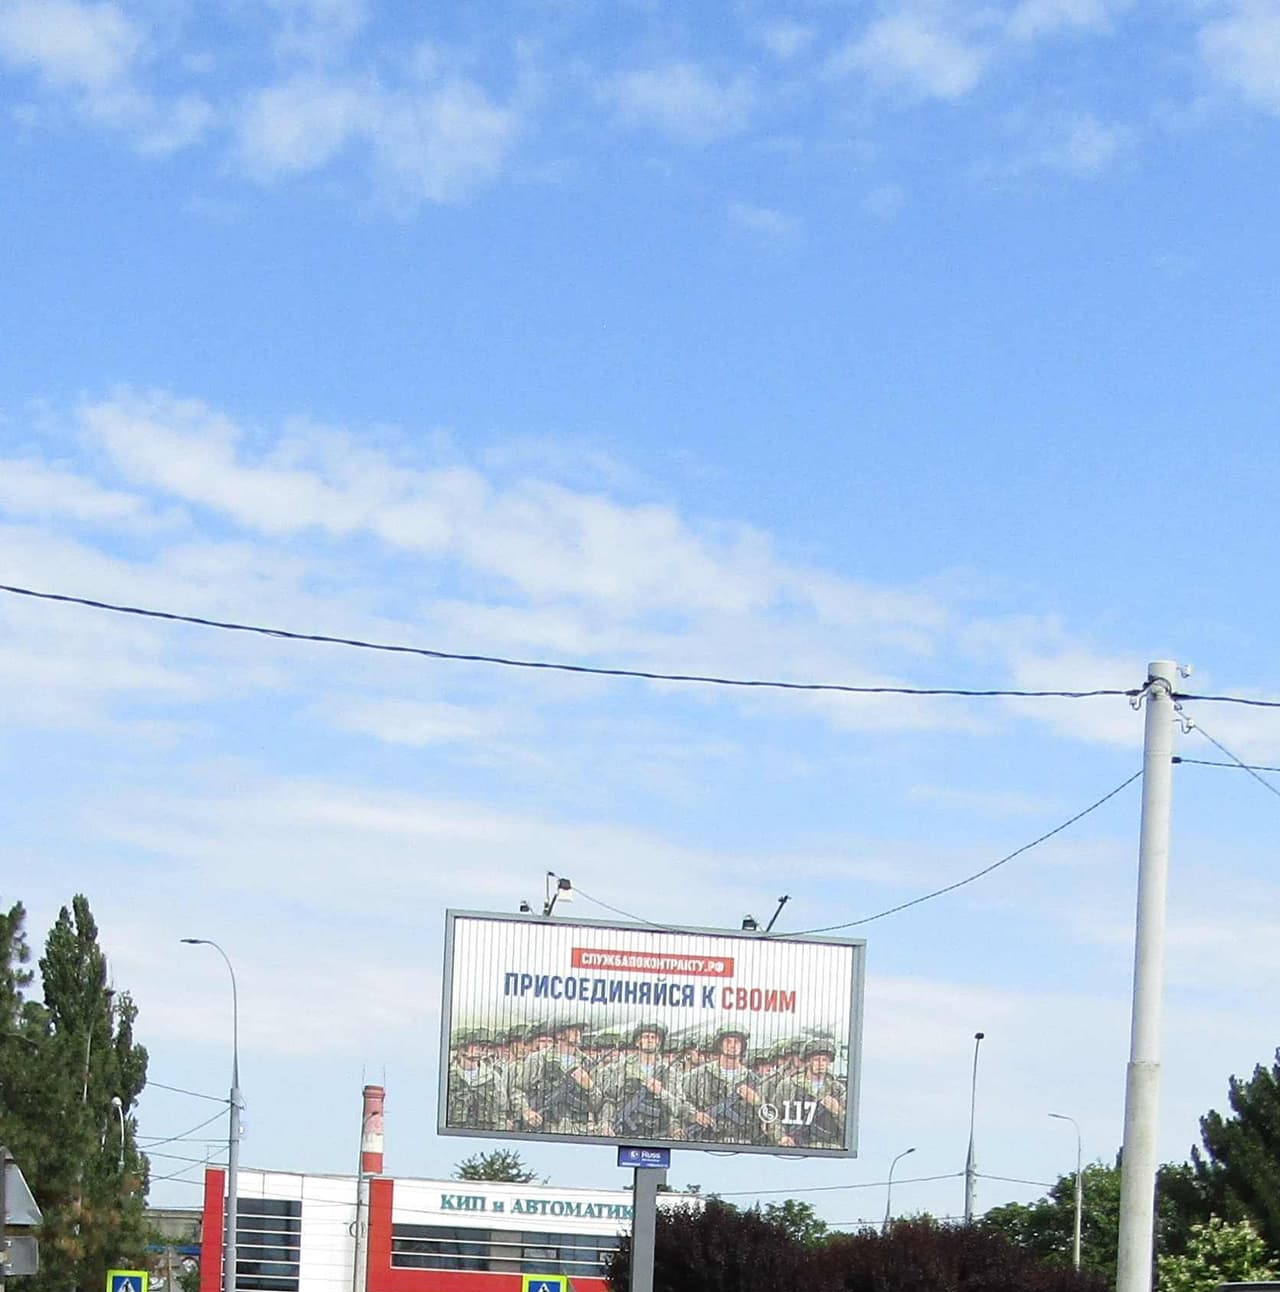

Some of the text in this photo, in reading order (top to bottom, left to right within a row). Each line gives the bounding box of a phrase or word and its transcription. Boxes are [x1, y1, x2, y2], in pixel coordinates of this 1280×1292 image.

[581, 952, 725, 973] СЛУЖБАПОКОНТРАКТУ.РФ
[504, 972, 797, 1014] ПРИСОЕДИНЯЙСЯ К СВОИМ
[781, 1100, 817, 1126] 117
[440, 1194, 634, 1220] КИП и АВТОМАТИК
